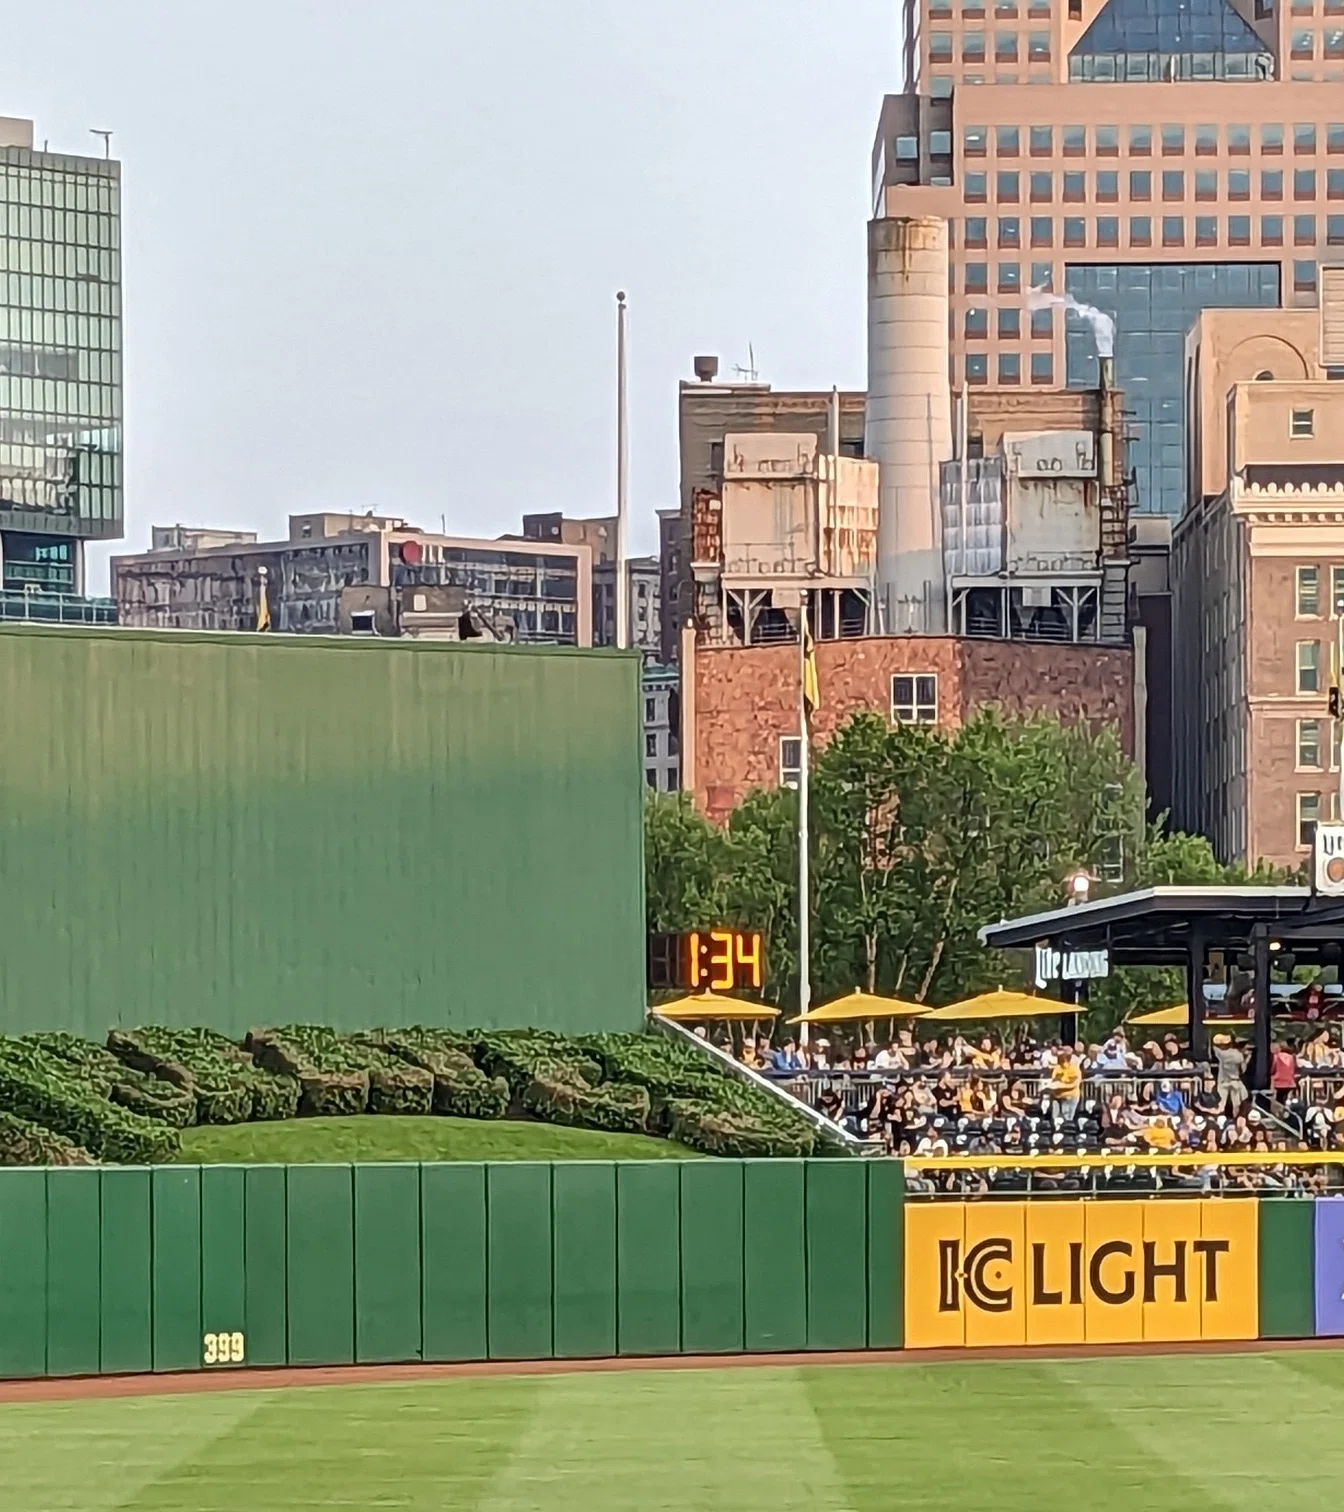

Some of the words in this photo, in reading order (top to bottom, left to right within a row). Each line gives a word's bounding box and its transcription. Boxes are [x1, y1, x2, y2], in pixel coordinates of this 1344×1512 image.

[690, 931, 763, 989] 1:34
[1033, 1241, 1229, 1305] LIGHT
[204, 1332, 244, 1363] 399
